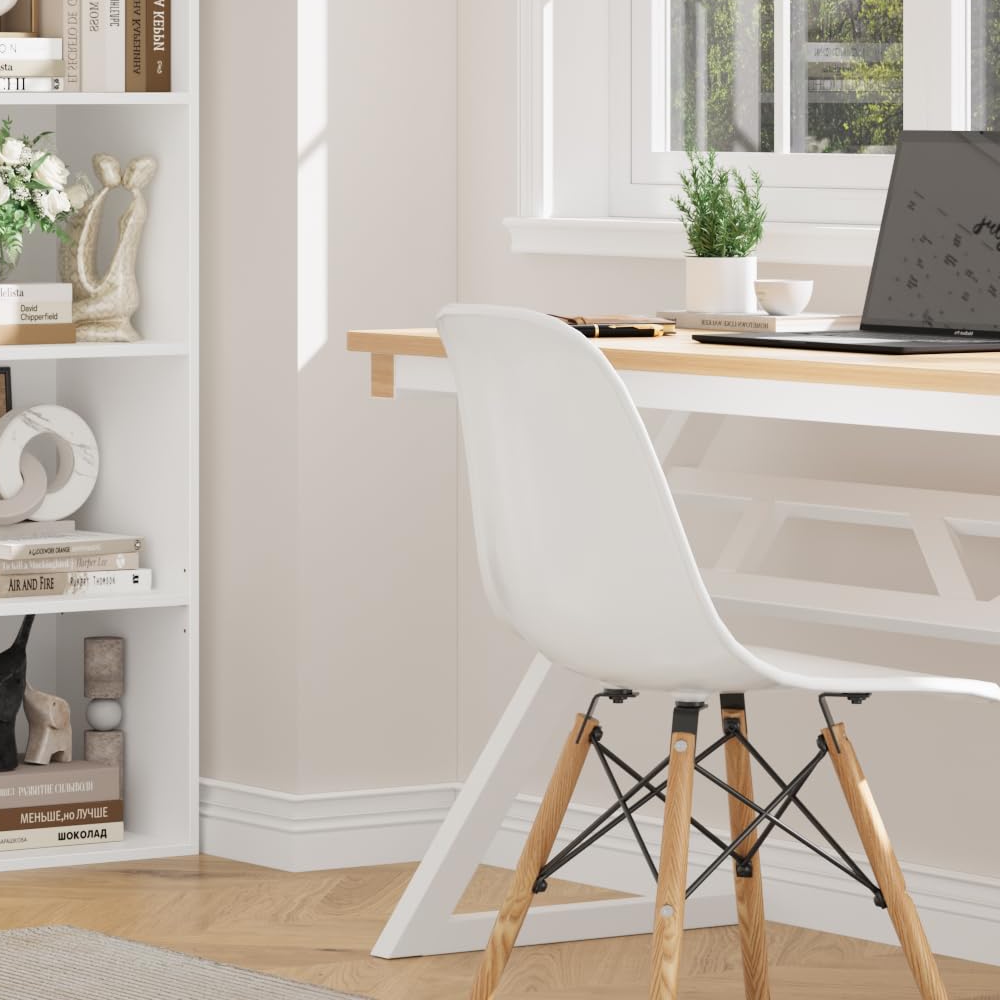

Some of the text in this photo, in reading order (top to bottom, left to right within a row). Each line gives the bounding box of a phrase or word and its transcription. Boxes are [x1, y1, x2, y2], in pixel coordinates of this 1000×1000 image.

[20, 304, 38, 312] David
[20, 313, 58, 322] Chipperfield
[76, 558, 96, 568] Harper
[8, 576, 54, 592] AIR AND FIRE
[76, 807, 108, 820] ЛУЧШЕ
[58, 829, 107, 841] ШОКОЛАД
